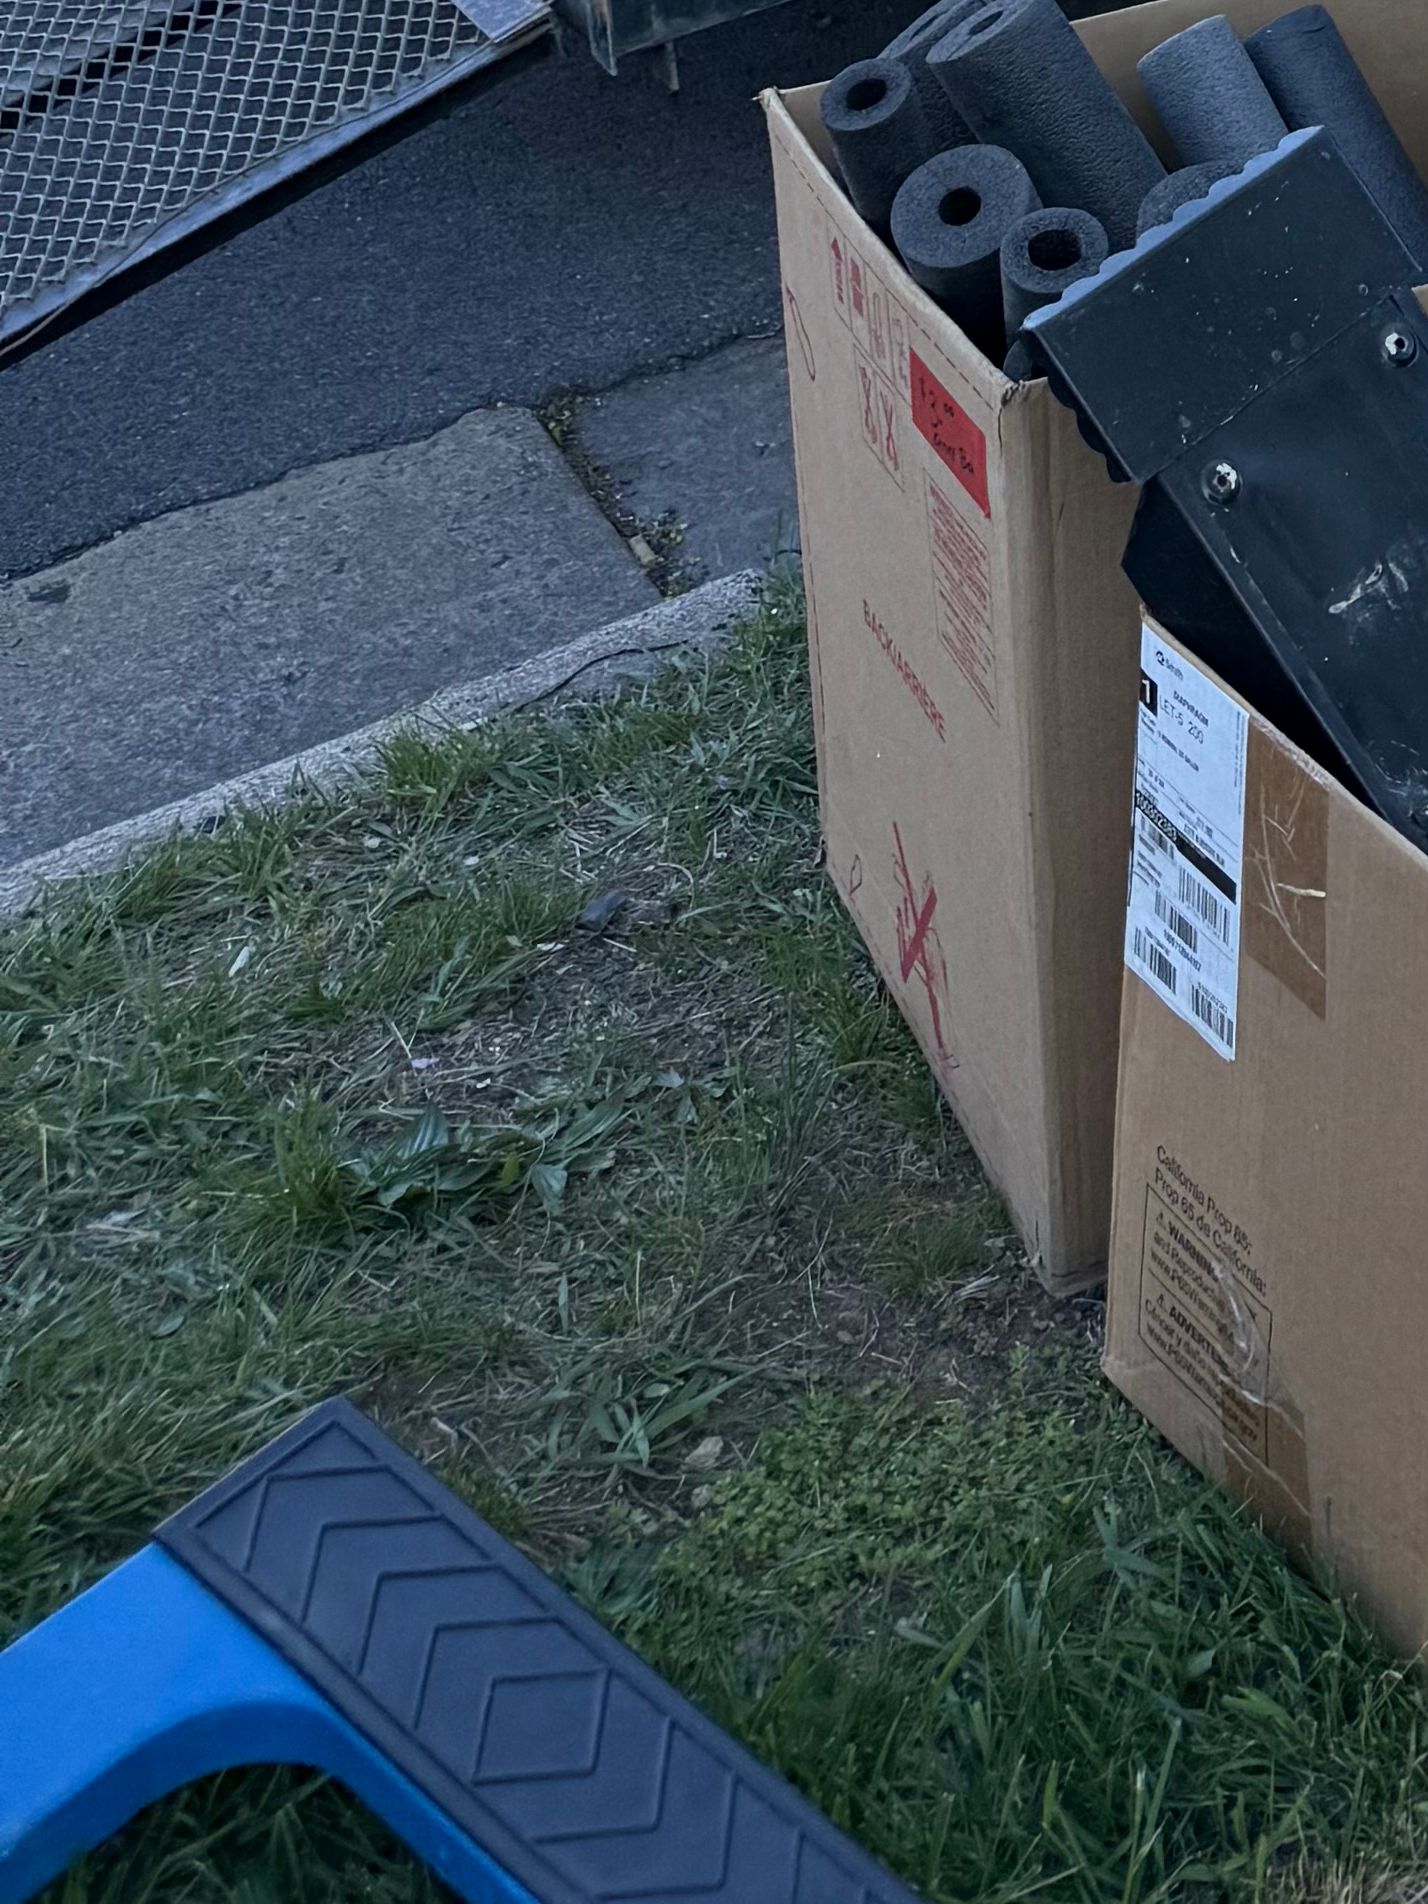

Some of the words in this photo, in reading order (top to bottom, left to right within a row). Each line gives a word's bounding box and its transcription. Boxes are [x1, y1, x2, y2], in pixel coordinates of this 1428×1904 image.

[1142, 679, 1151, 705] 1
[1154, 1167, 1180, 1206] Prop
[1180, 1198, 1195, 1223] 65
[1196, 1215, 1211, 1240] de
[1156, 1145, 1205, 1207] California
[1206, 1195, 1232, 1234] Prop
